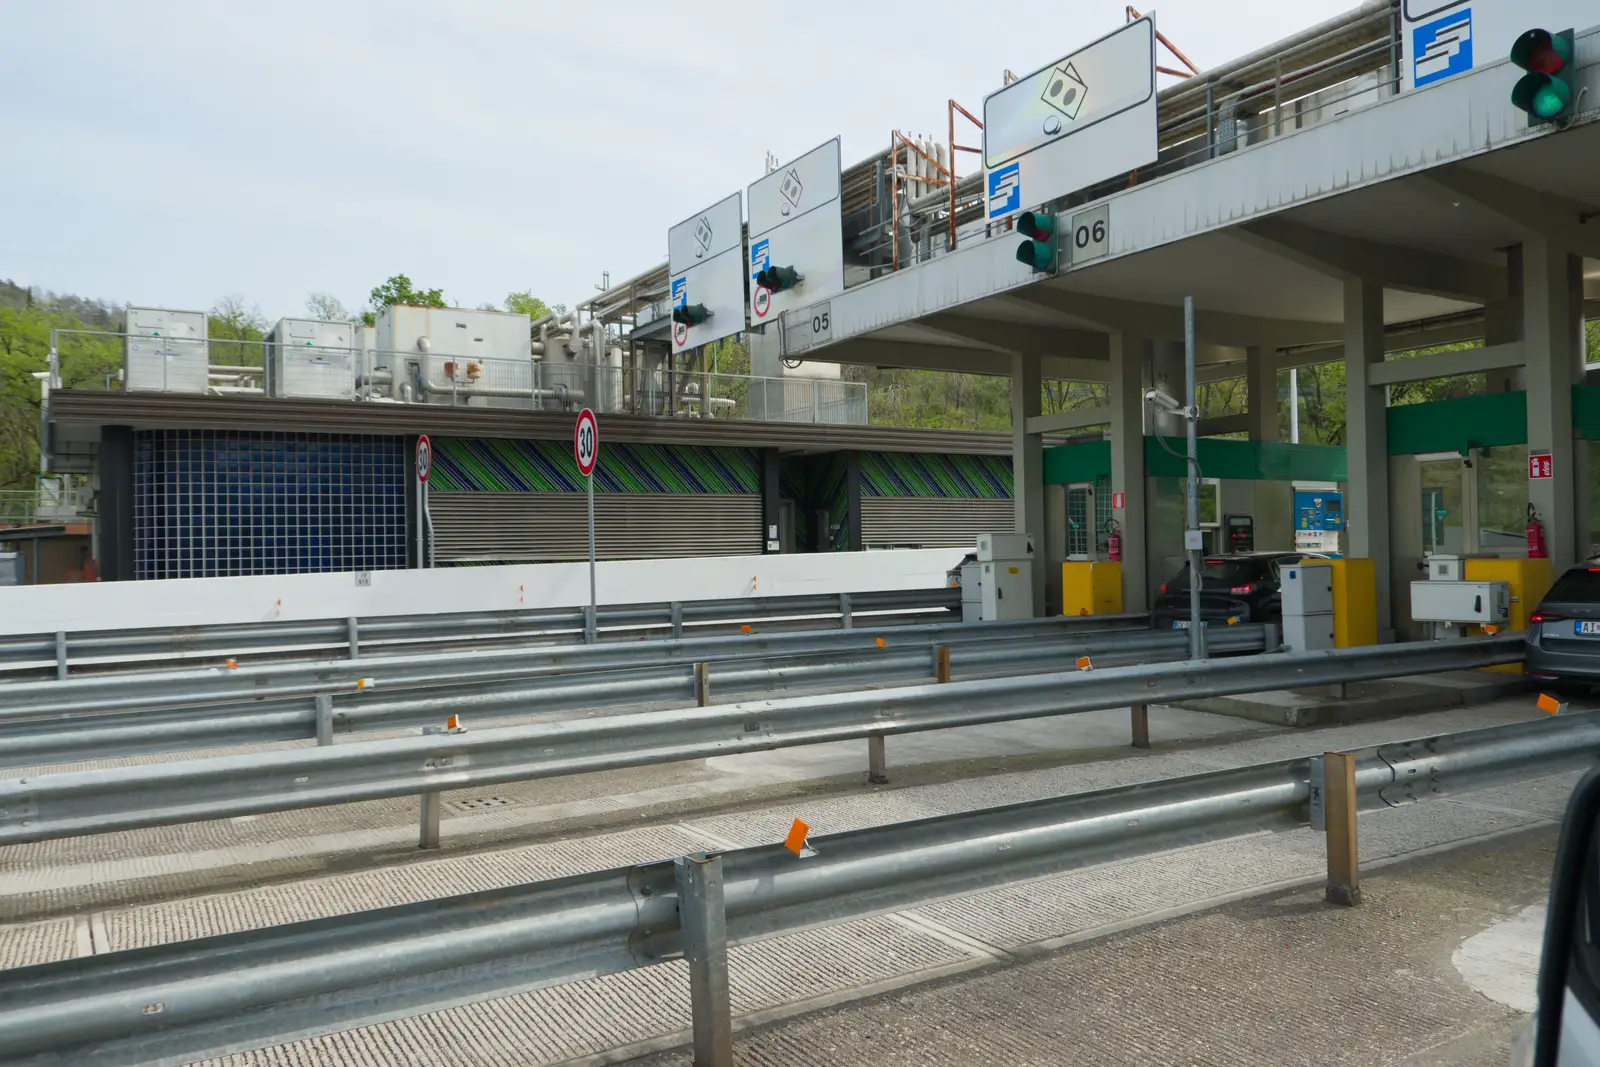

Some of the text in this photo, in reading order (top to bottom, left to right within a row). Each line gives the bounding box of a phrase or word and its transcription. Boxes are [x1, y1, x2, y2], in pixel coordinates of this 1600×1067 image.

[1076, 219, 1105, 249] 06
[813, 312, 829, 333] 05
[580, 426, 592, 458] 30
[419, 446, 427, 470] 30
